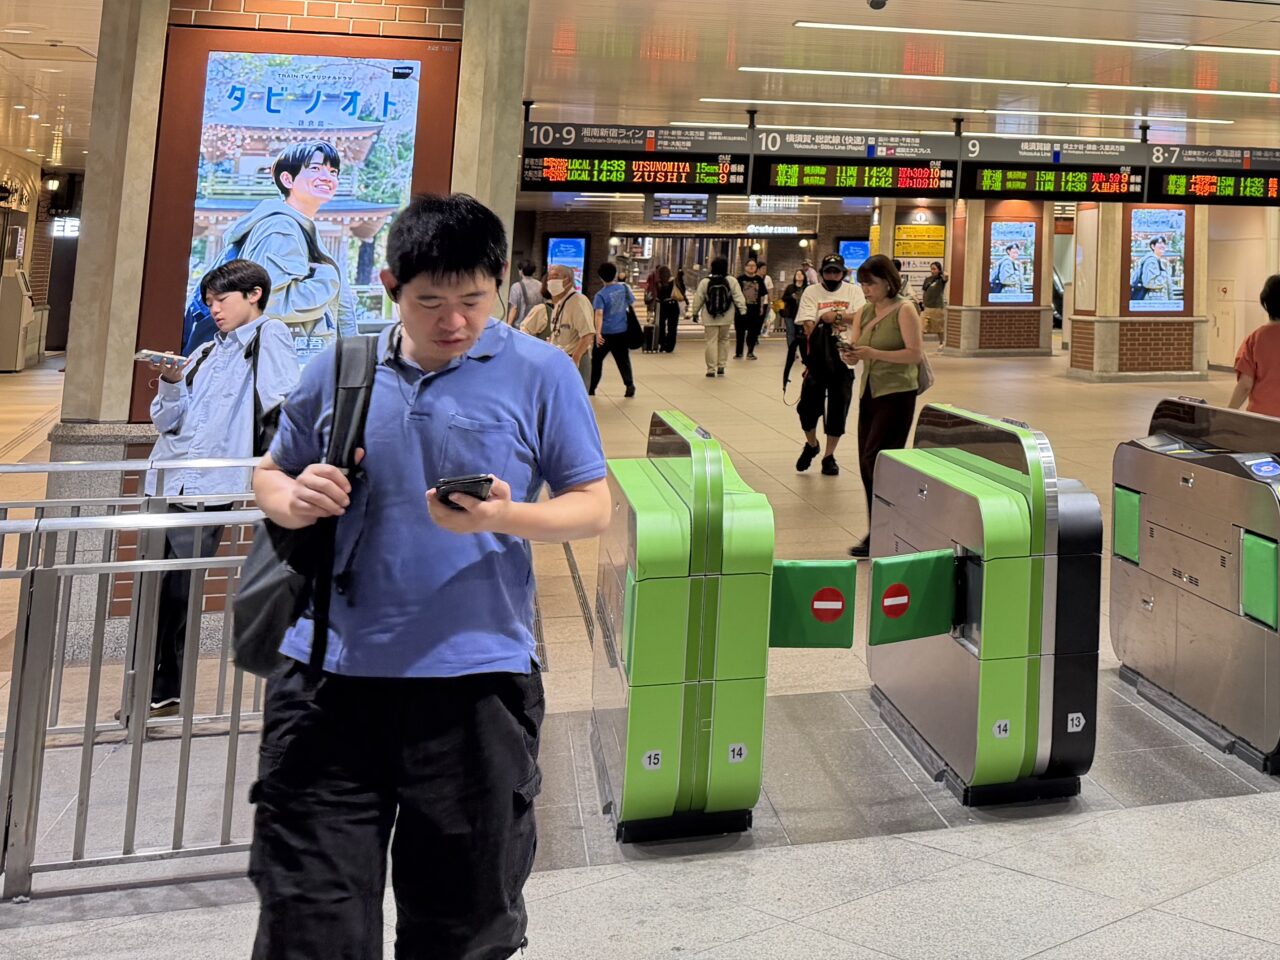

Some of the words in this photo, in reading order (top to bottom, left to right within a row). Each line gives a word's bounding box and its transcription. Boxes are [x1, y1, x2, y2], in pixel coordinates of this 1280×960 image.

[227, 85, 397, 118] タビノオト
[581, 127, 644, 138] 湘南新宿ライン
[758, 132, 781, 152] 10
[967, 140, 980, 158] 9
[568, 159, 591, 170] LOCAL
[593, 160, 626, 171] 14:33
[632, 161, 690, 172] UTSUNOMIYA
[718, 163, 730, 173] 10
[864, 167, 893, 178] 14:24
[930, 168, 940, 178] 10
[567, 170, 591, 181] LOCAL
[592, 171, 625, 182] 14:49
[633, 172, 687, 183] ZUSHI
[719, 174, 728, 184] 9
[864, 177, 892, 188] 14:42
[929, 179, 939, 188] 10
[1061, 171, 1088, 182] 14:26
[1121, 173, 1129, 182] 9
[1060, 182, 1087, 192] 14:39
[1091, 182, 1120, 192] 久里浜
[1120, 183, 1128, 192] 9
[1069, 715, 1082, 728] 13
[997, 722, 1009, 735] 14
[730, 746, 743, 759] 14
[647, 753, 660, 766] 15
